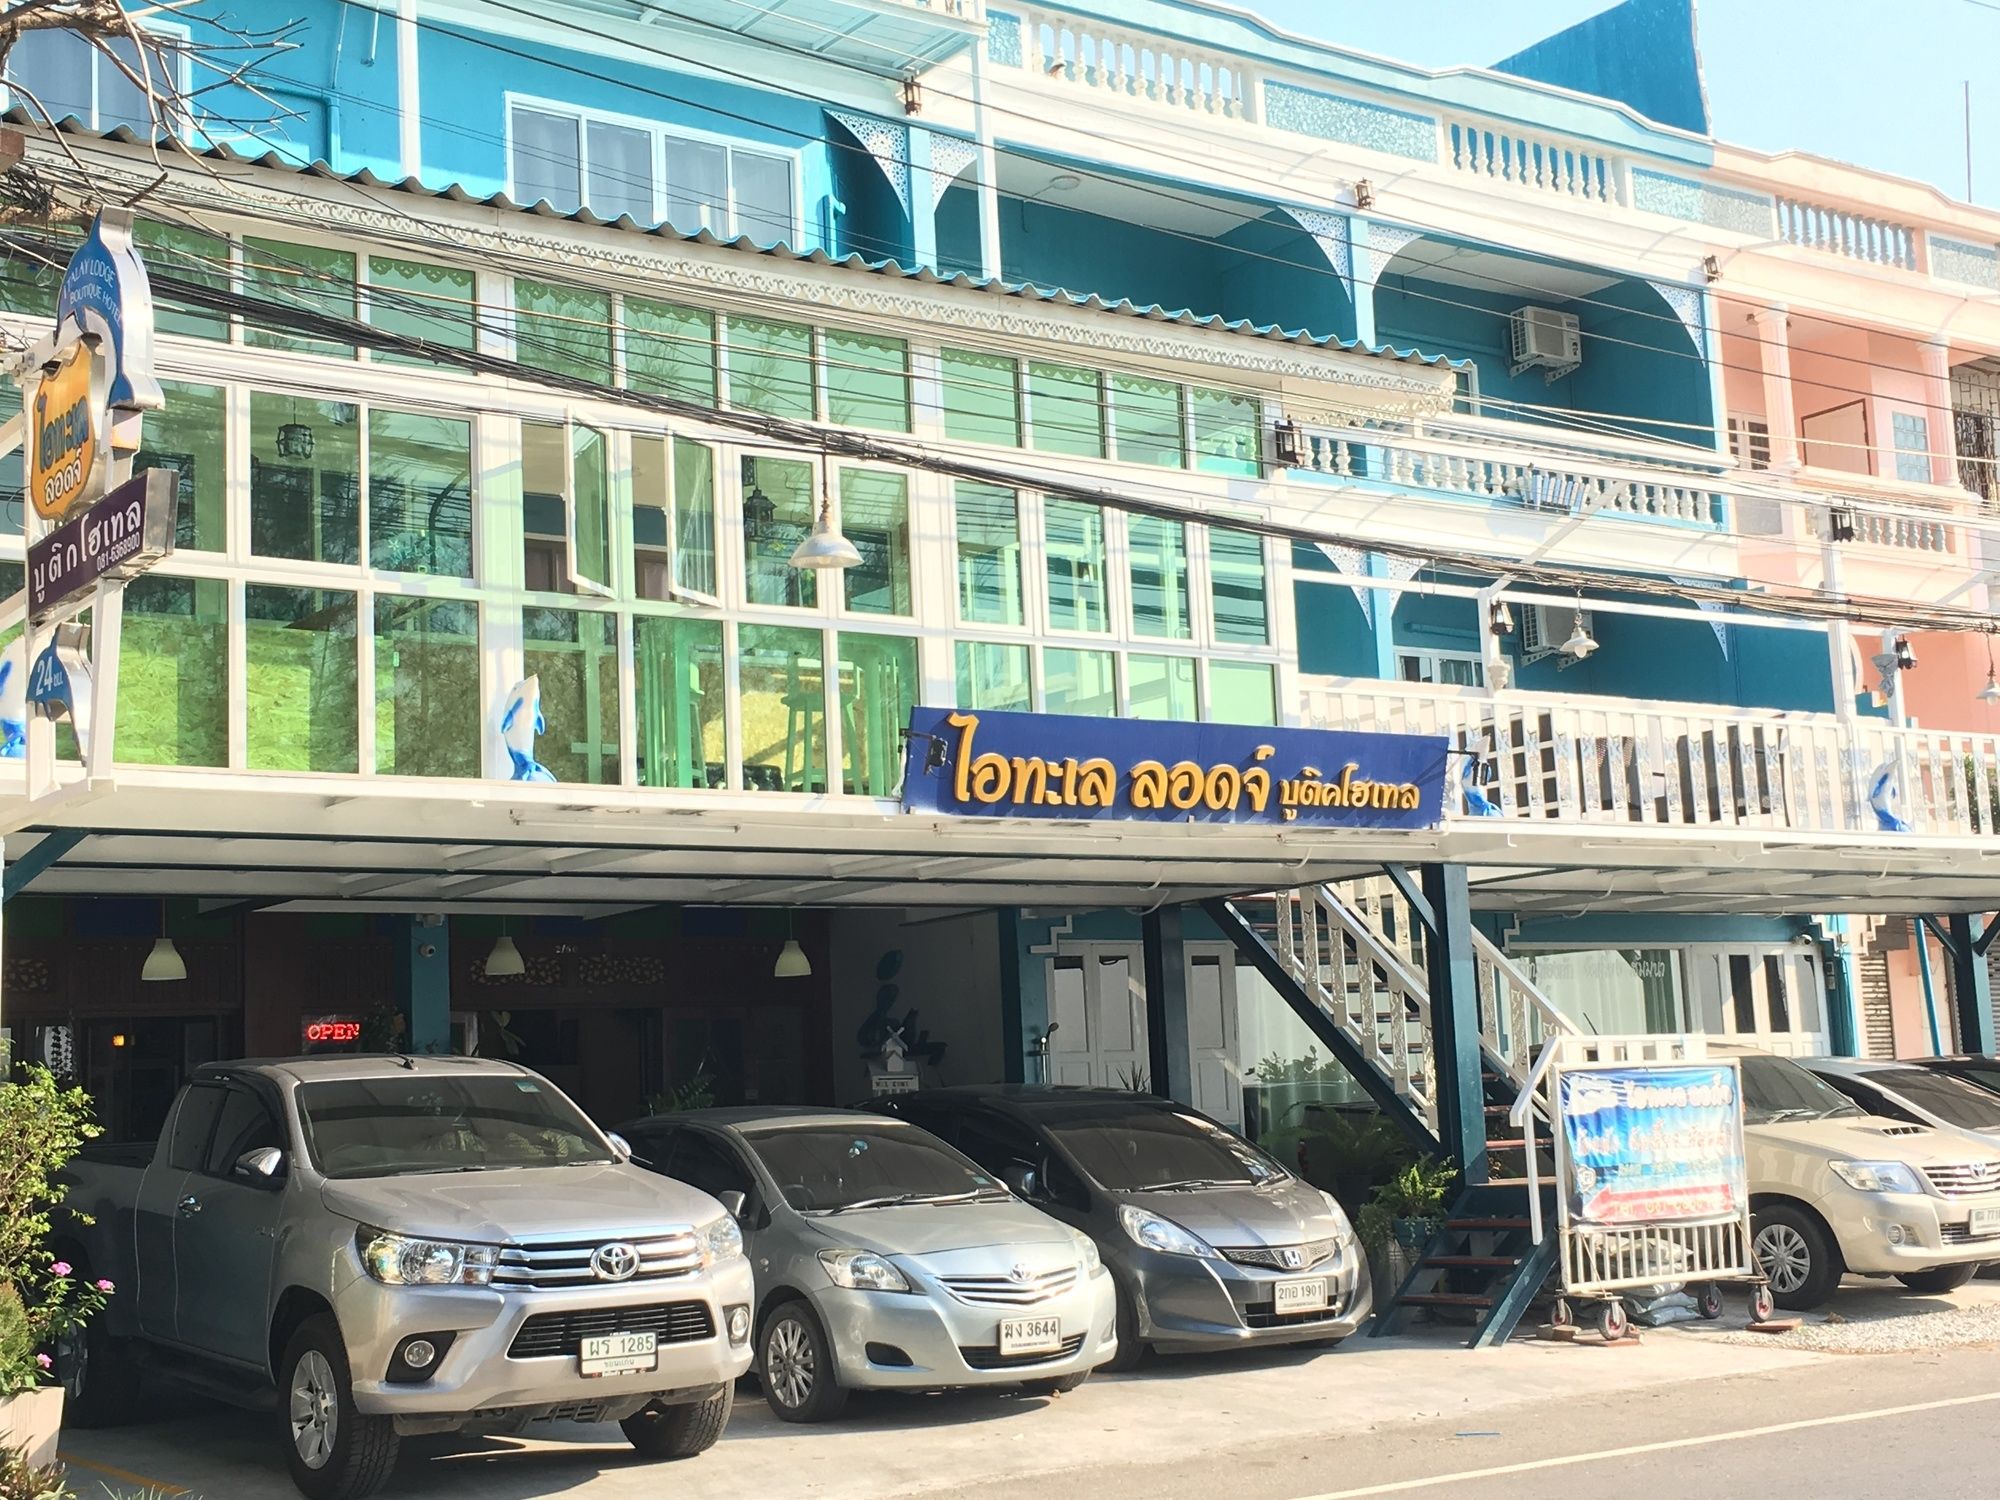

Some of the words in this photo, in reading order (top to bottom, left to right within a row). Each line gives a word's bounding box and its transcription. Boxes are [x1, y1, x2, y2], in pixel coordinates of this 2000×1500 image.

[90, 259, 115, 288] LODGE
[70, 283, 102, 305] BOUTIQUE
[37, 392, 89, 473] ไอทะเล
[44, 447, 83, 506] ลอดจ์
[36, 656, 53, 696] 24
[948, 712, 1117, 808] ไอทะเล
[1130, 745, 1276, 812] ลอดจ์
[308, 1023, 360, 1040] OPEN
[1301, 1284, 1322, 1297] 1901
[1027, 1320, 1057, 1337] 3644
[620, 1335, 654, 1354] 1285
